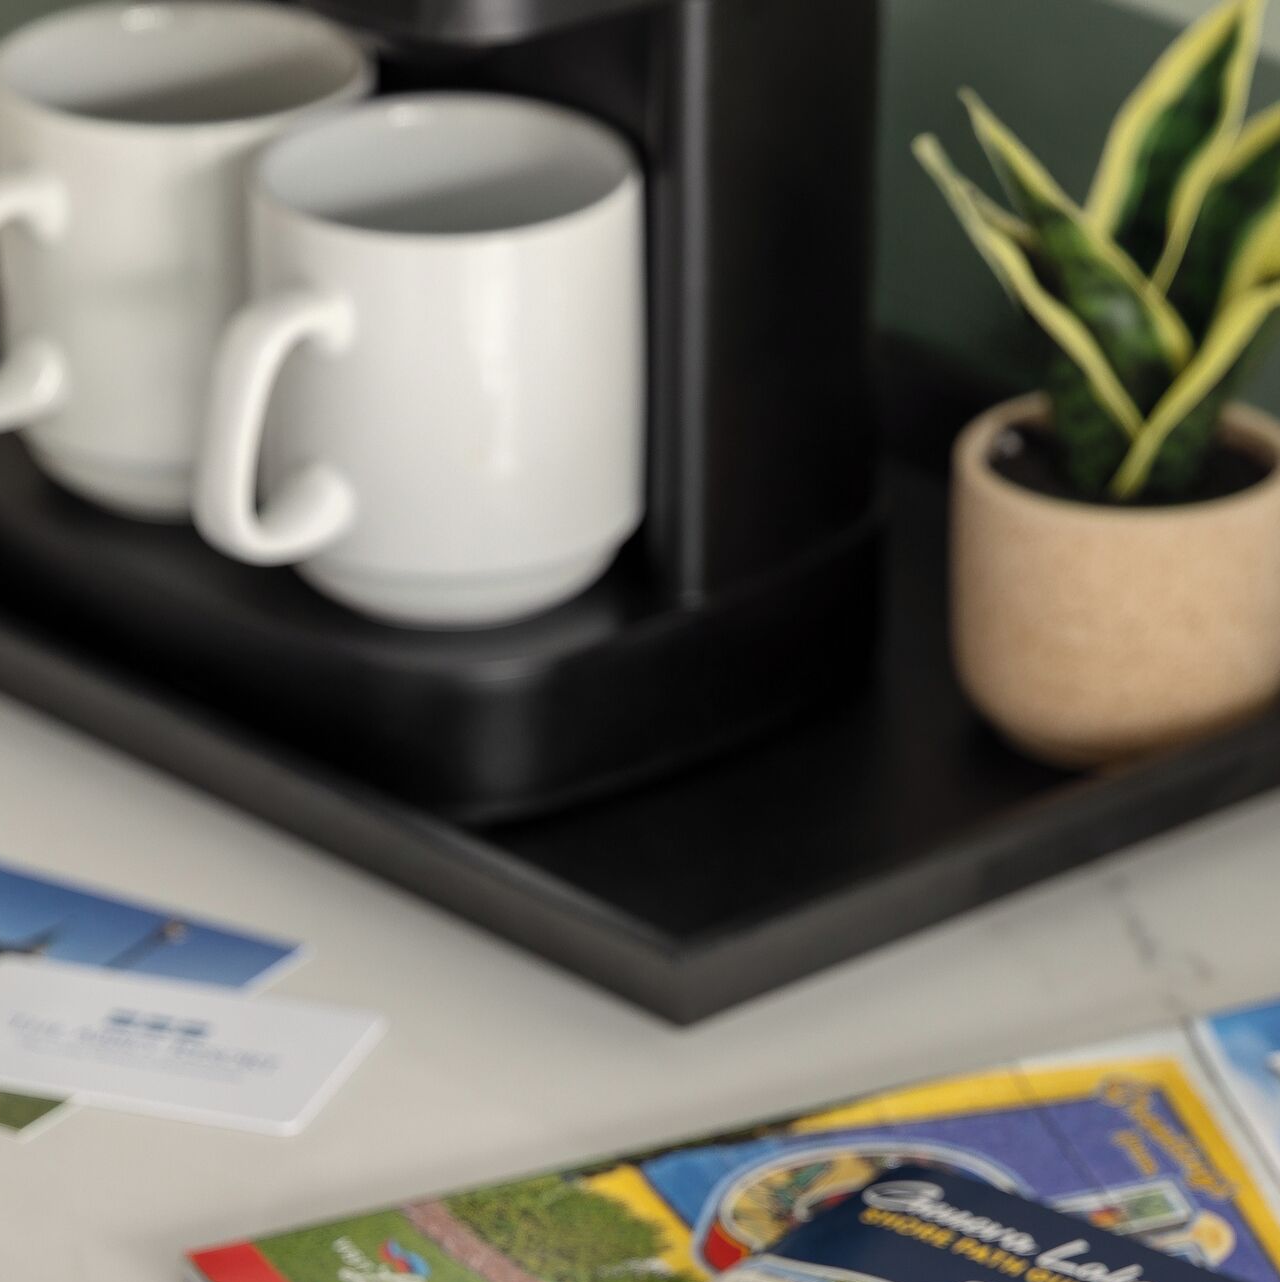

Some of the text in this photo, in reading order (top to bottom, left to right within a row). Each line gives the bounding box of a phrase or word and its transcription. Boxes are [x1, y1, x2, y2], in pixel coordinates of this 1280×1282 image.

[859, 1206, 957, 1249] SHORE
[951, 1236, 1029, 1277] PATH
[862, 1180, 1039, 1256] Geneva
